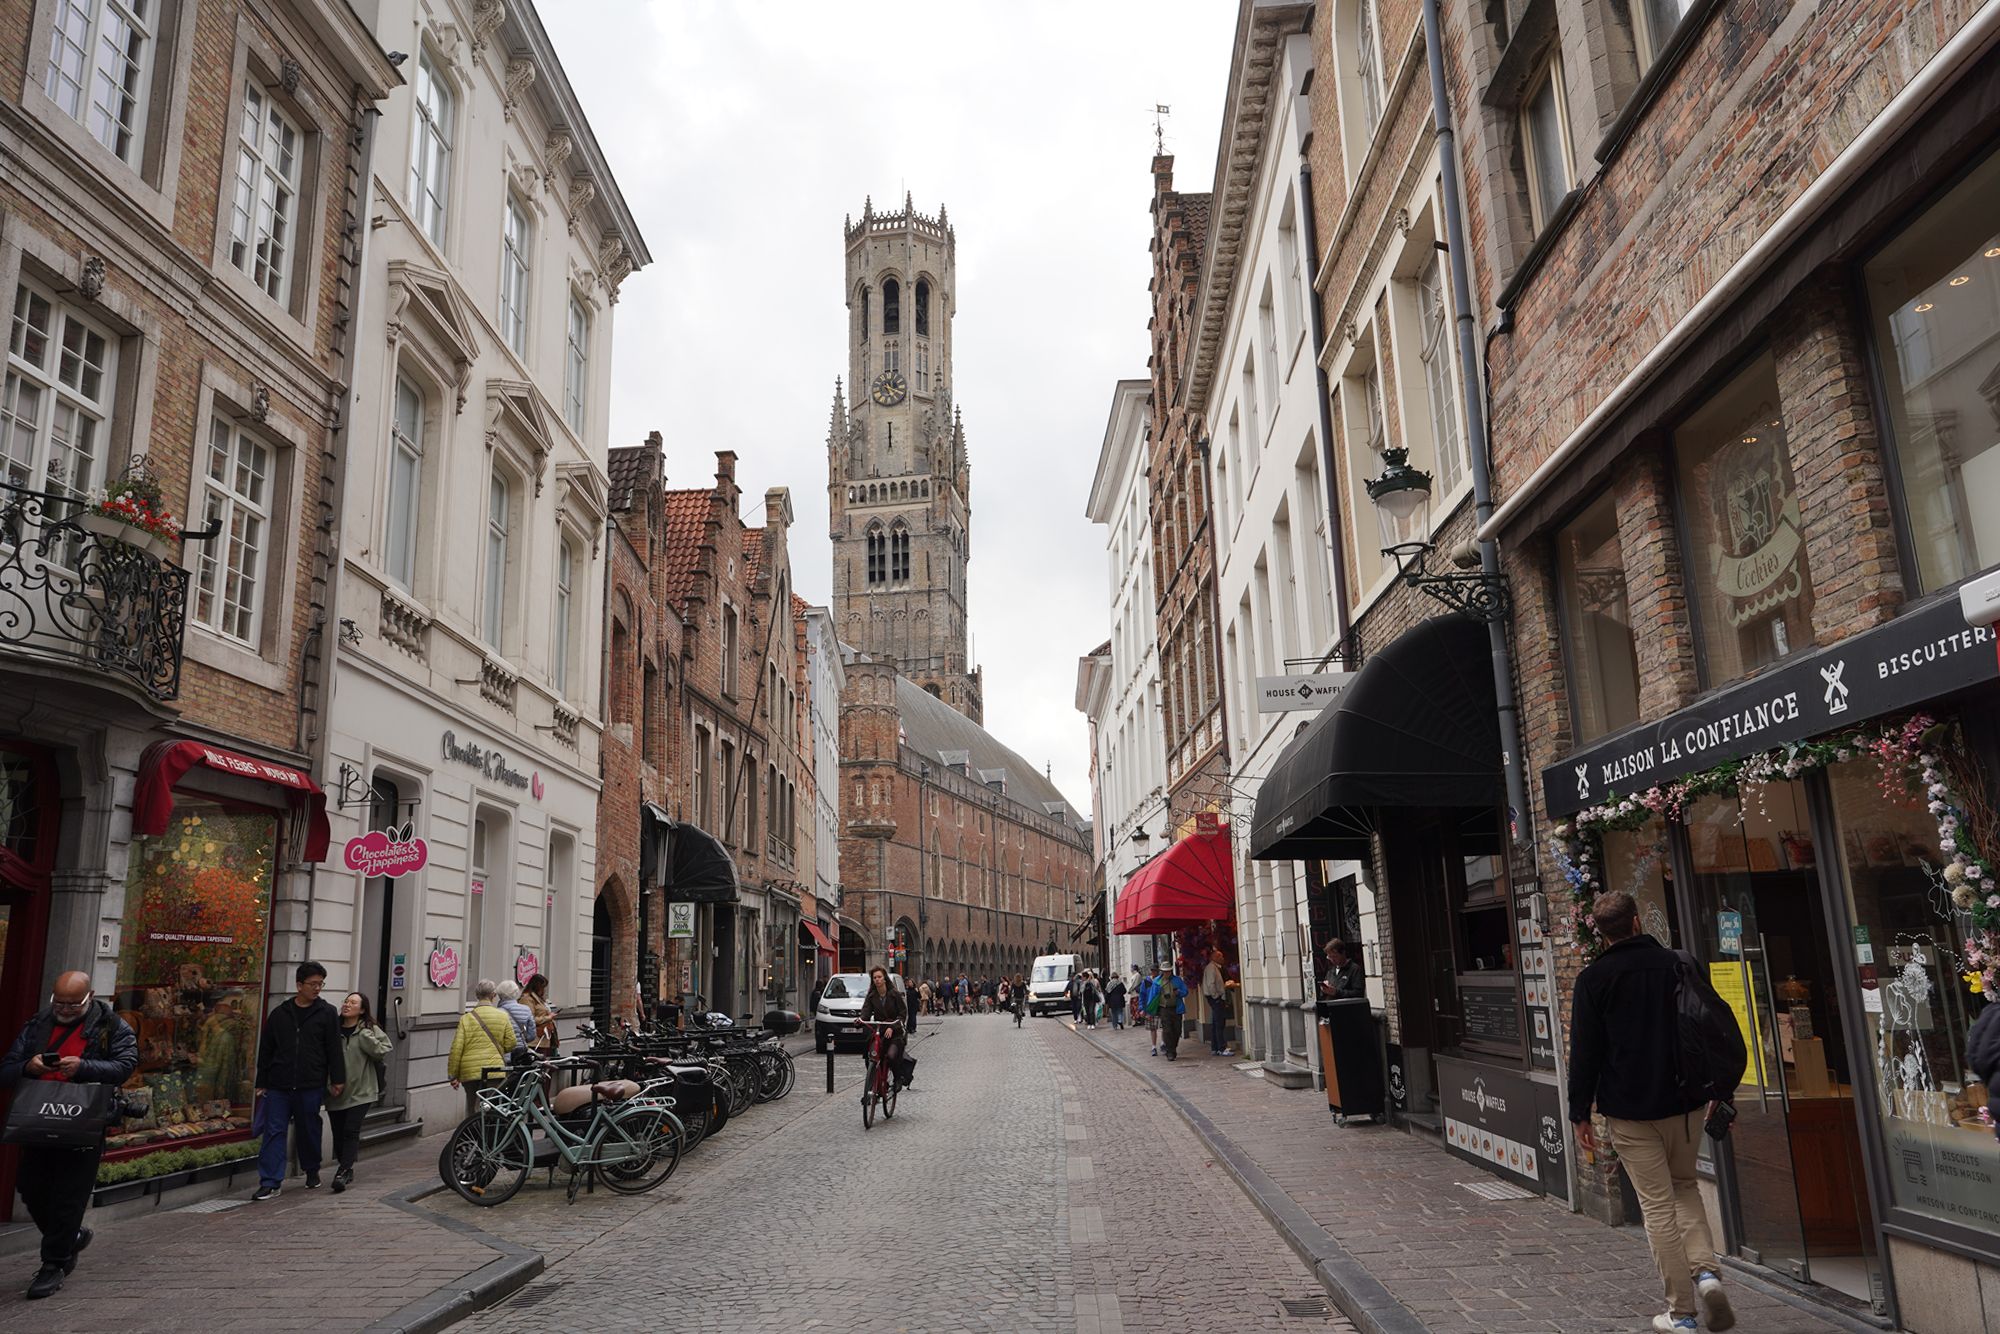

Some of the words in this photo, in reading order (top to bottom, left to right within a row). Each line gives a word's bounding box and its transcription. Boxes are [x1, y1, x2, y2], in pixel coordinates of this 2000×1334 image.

[1736, 555, 1780, 590] Cookies
[1266, 688, 1296, 698] HOUSE
[1315, 686, 1345, 695] WAFFL
[1602, 746, 1655, 785] MAISON
[1660, 737, 1682, 764] LA
[1685, 691, 1800, 755] CONFIANCE
[350, 844, 408, 862] Chocolates
[408, 839, 420, 853] &
[358, 852, 420, 875] Happiness
[38, 1103, 82, 1117] INNO
[1461, 1088, 1477, 1104] HOUSE
[1485, 1094, 1506, 1112] WAFFLES
[1941, 1150, 1980, 1167] BISCUITS
[1936, 1163, 1958, 1177] FAITS
[1960, 1169, 1992, 1184] MAISON
[1916, 1193, 1945, 1209] MAISON
[1946, 1203, 1956, 1212] LA
[1958, 1205, 2000, 1224] CONFIANC
